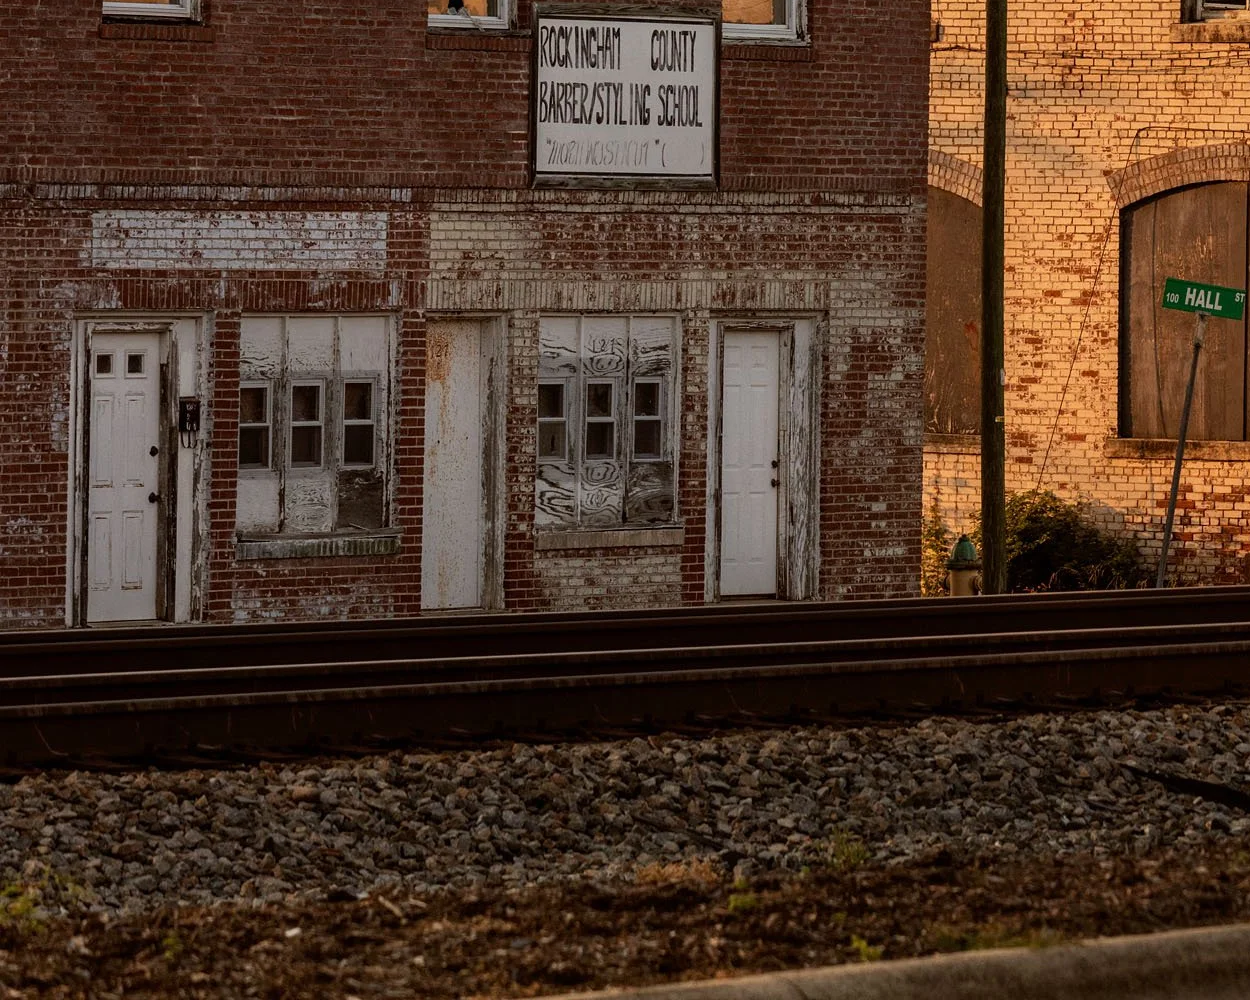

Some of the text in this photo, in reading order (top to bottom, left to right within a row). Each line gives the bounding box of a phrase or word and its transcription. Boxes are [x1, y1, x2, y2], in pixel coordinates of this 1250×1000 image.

[540, 25, 697, 72] ROCKINGHAM COUNTY
[657, 84, 703, 127] SCHOOL
[1166, 287, 1246, 311] 100 HALL ST
